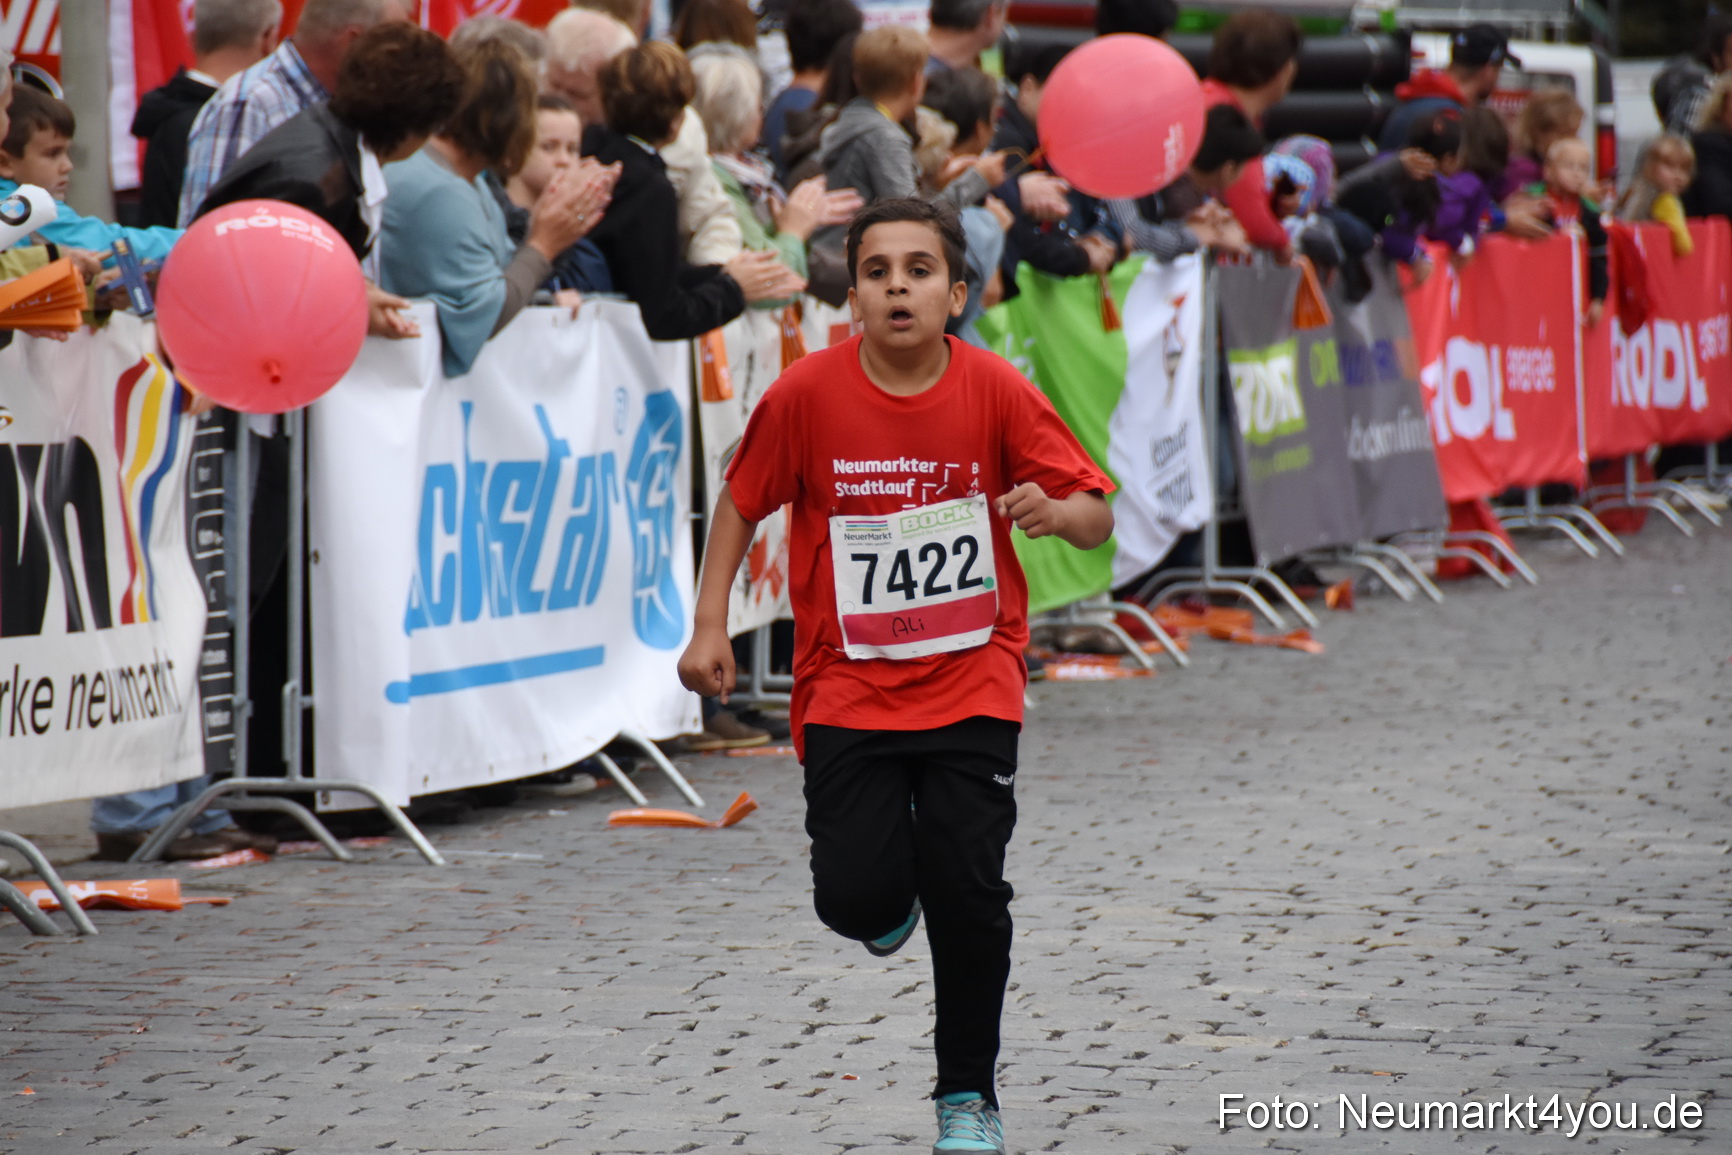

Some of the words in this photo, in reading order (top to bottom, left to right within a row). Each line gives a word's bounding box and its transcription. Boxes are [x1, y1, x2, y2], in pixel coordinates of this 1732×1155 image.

[833, 457, 938, 475] Neumarkter
[834, 478, 916, 498] Stadtlauf
[899, 502, 975, 534] BOCK
[843, 532, 893, 541] NeuerMarkt
[851, 534, 984, 605] 7422
[65, 647, 182, 731] neumarkt
